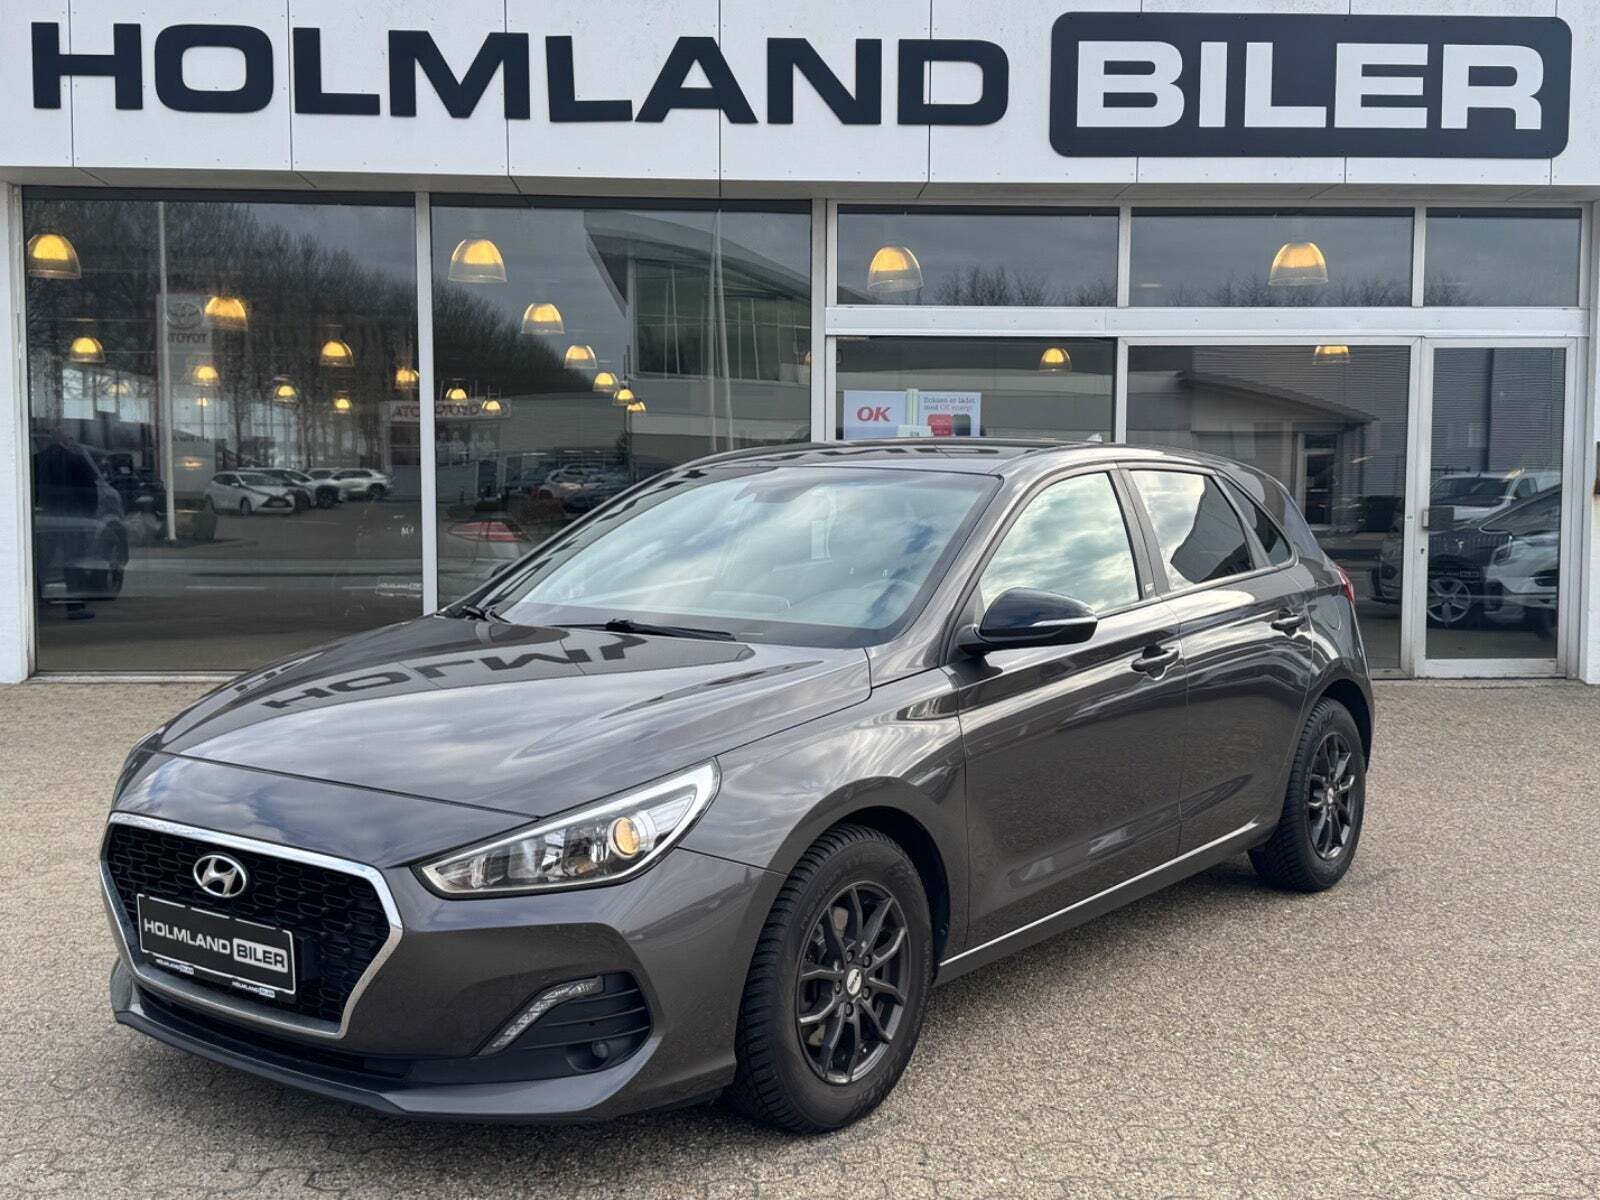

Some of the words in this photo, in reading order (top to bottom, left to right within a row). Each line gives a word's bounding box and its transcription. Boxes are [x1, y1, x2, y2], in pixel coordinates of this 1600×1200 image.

[31, 22, 1009, 126] HOLMLAND
[1076, 40, 1544, 131] BILER
[857, 406, 891, 422] OK
[143, 918, 231, 955] HOLMLAND
[236, 943, 286, 969] BILER
